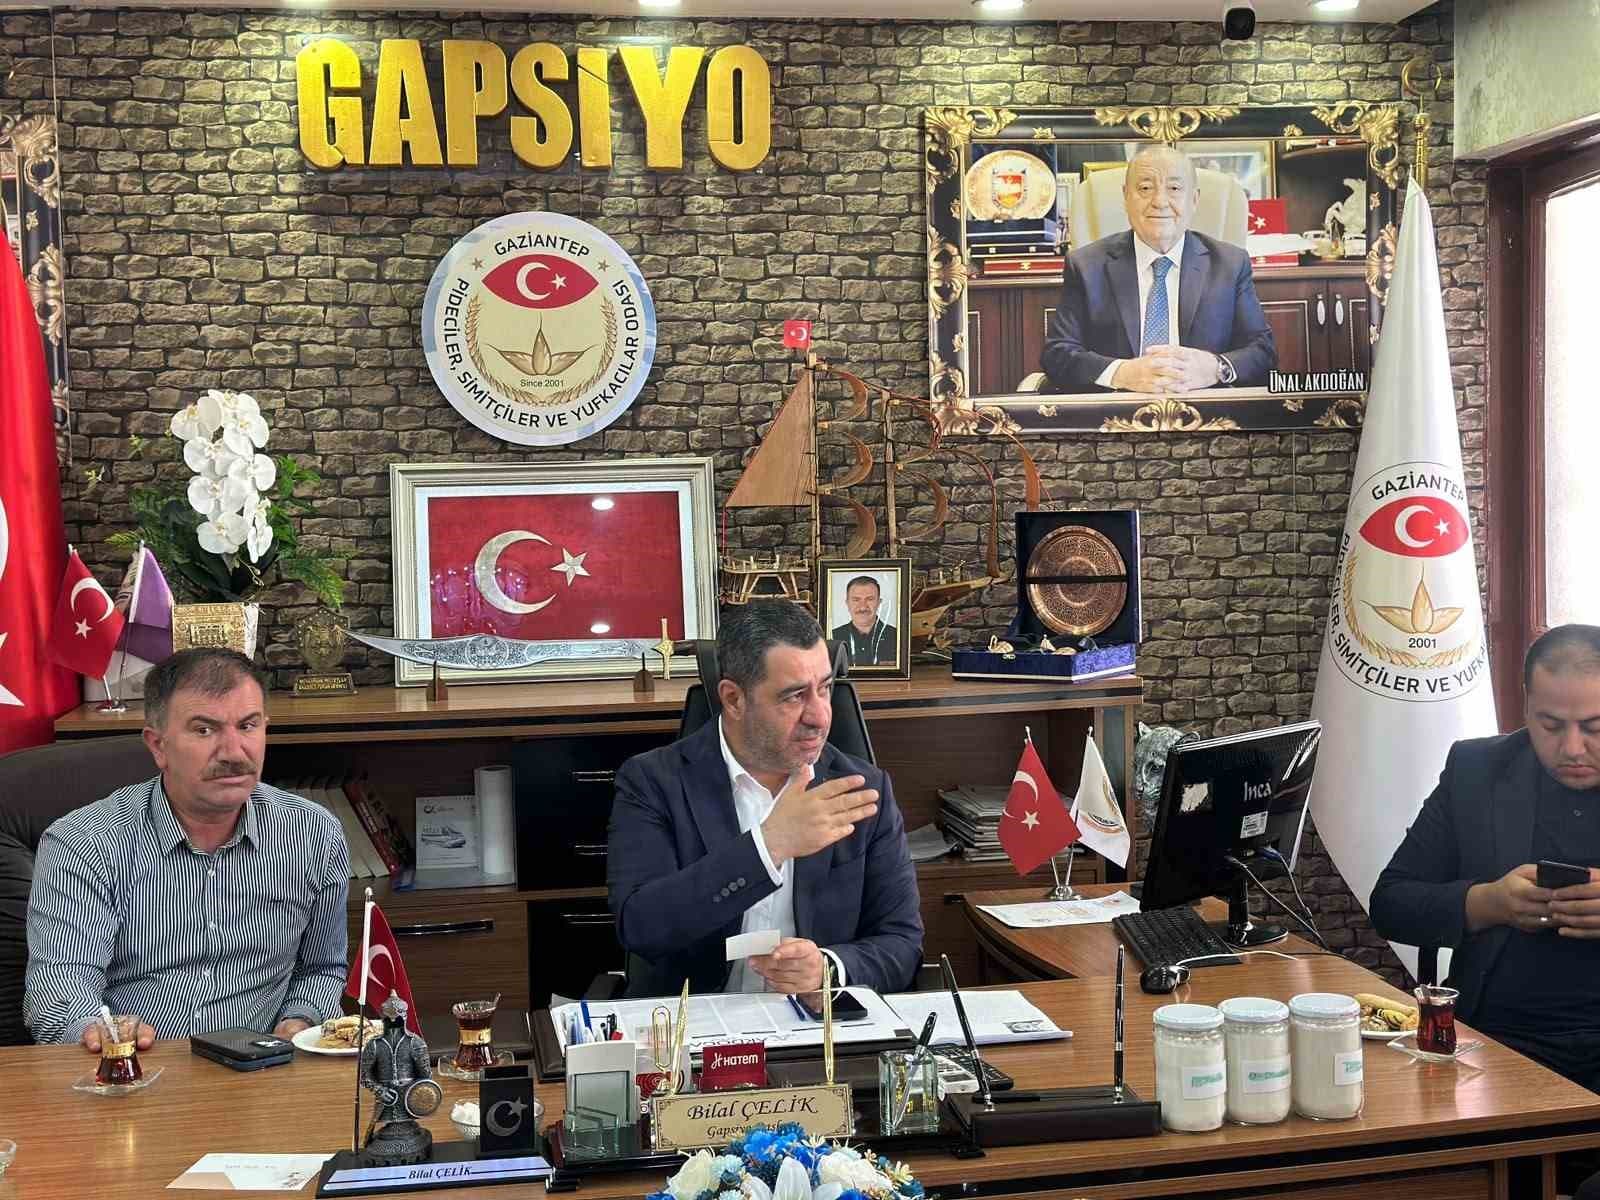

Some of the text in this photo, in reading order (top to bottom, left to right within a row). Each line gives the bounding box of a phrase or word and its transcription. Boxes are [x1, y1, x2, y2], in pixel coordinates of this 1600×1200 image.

[494, 231, 590, 258] GAZİANTEP
[457, 371, 540, 428] SİMİTÇİLER
[545, 413, 569, 428] VE
[571, 337, 639, 422] YUFKACILAR
[612, 279, 639, 331] ODASI
[520, 379, 565, 388] Since 2001
[1269, 369, 1364, 392] ÜNAL AKDOĞAN
[1408, 638, 1437, 648] 2001
[1334, 633, 1419, 693] SİMİTÇİLER
[1426, 677, 1451, 693] VE
[687, 1094, 818, 1121] Bilal ÇELİK
[408, 1164, 473, 1179] Bilal ÇELİK
